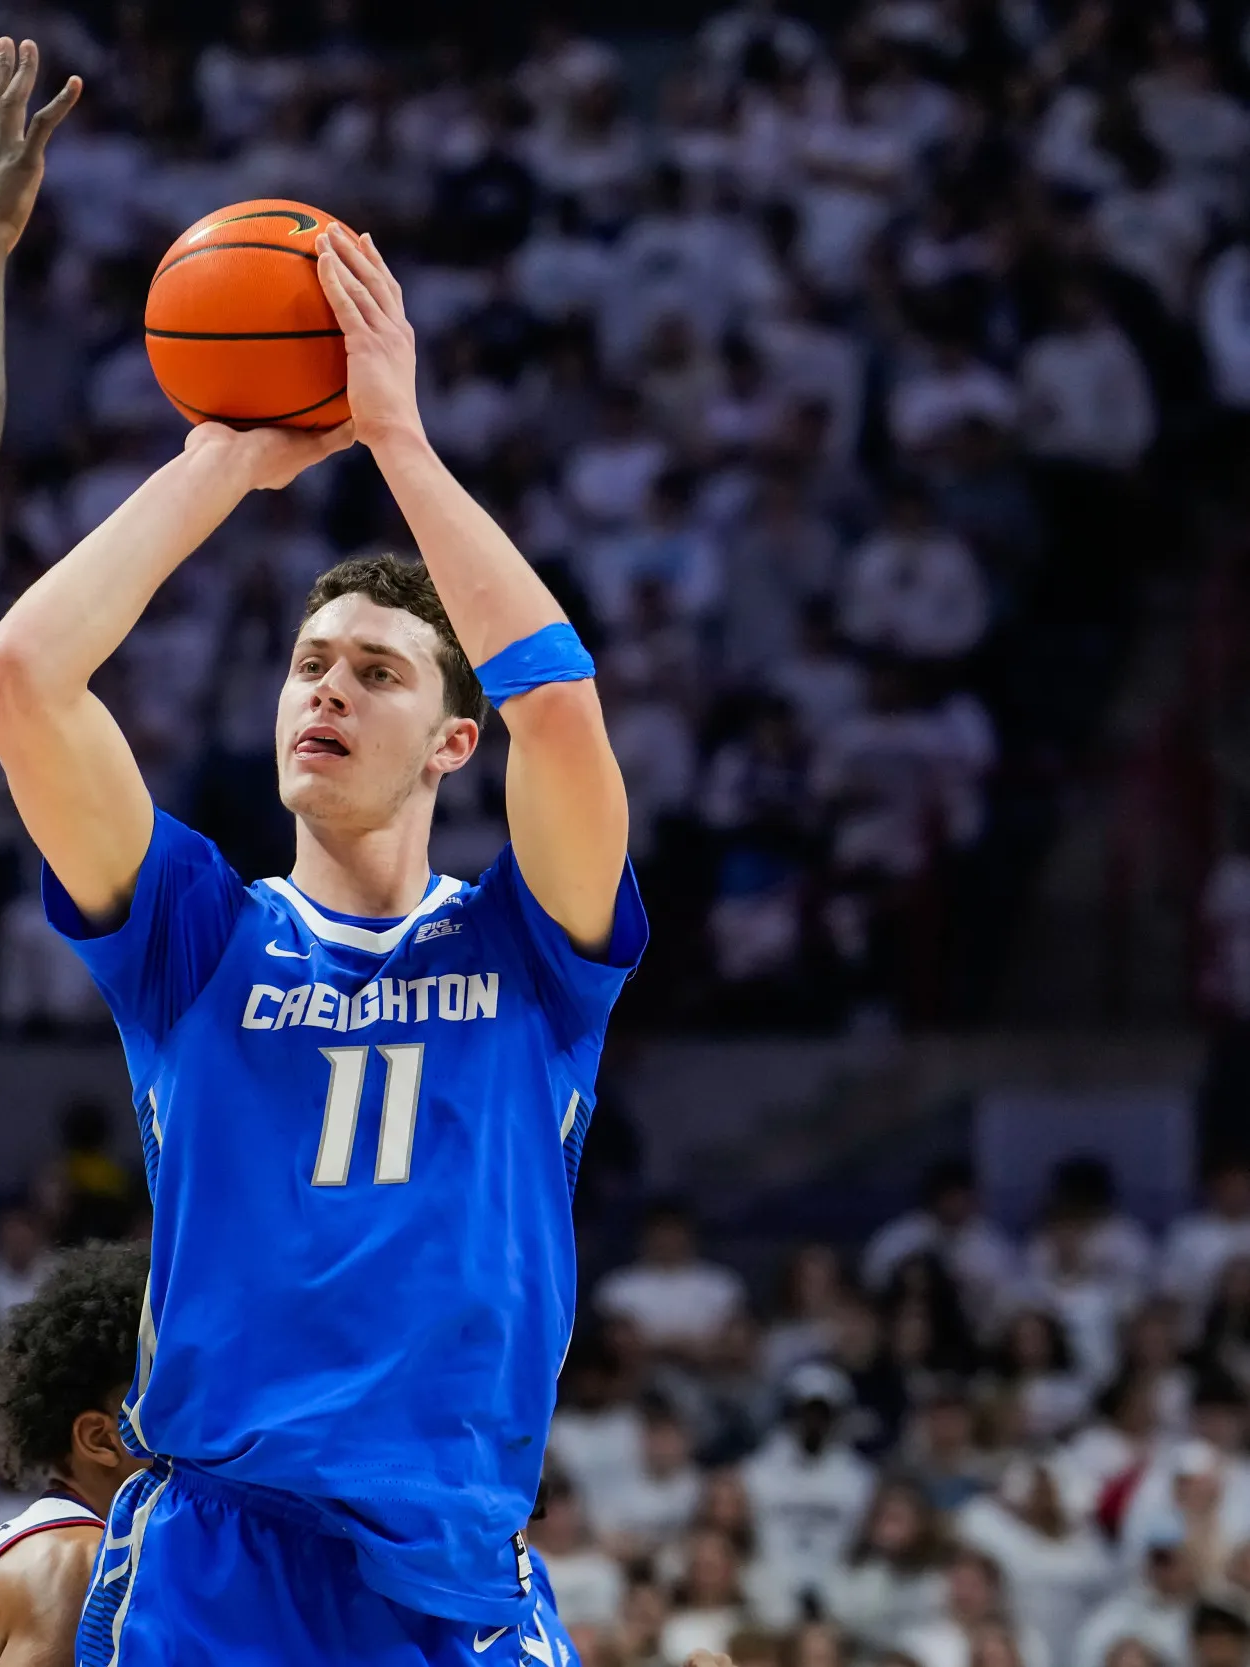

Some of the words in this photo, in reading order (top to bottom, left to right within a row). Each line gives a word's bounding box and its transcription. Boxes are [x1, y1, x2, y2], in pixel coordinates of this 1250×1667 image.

[415, 923, 463, 941] EAST
[418, 918, 451, 932] BIG
[241, 972, 499, 1033] CREIGHTON
[310, 1042, 425, 1187] 11
